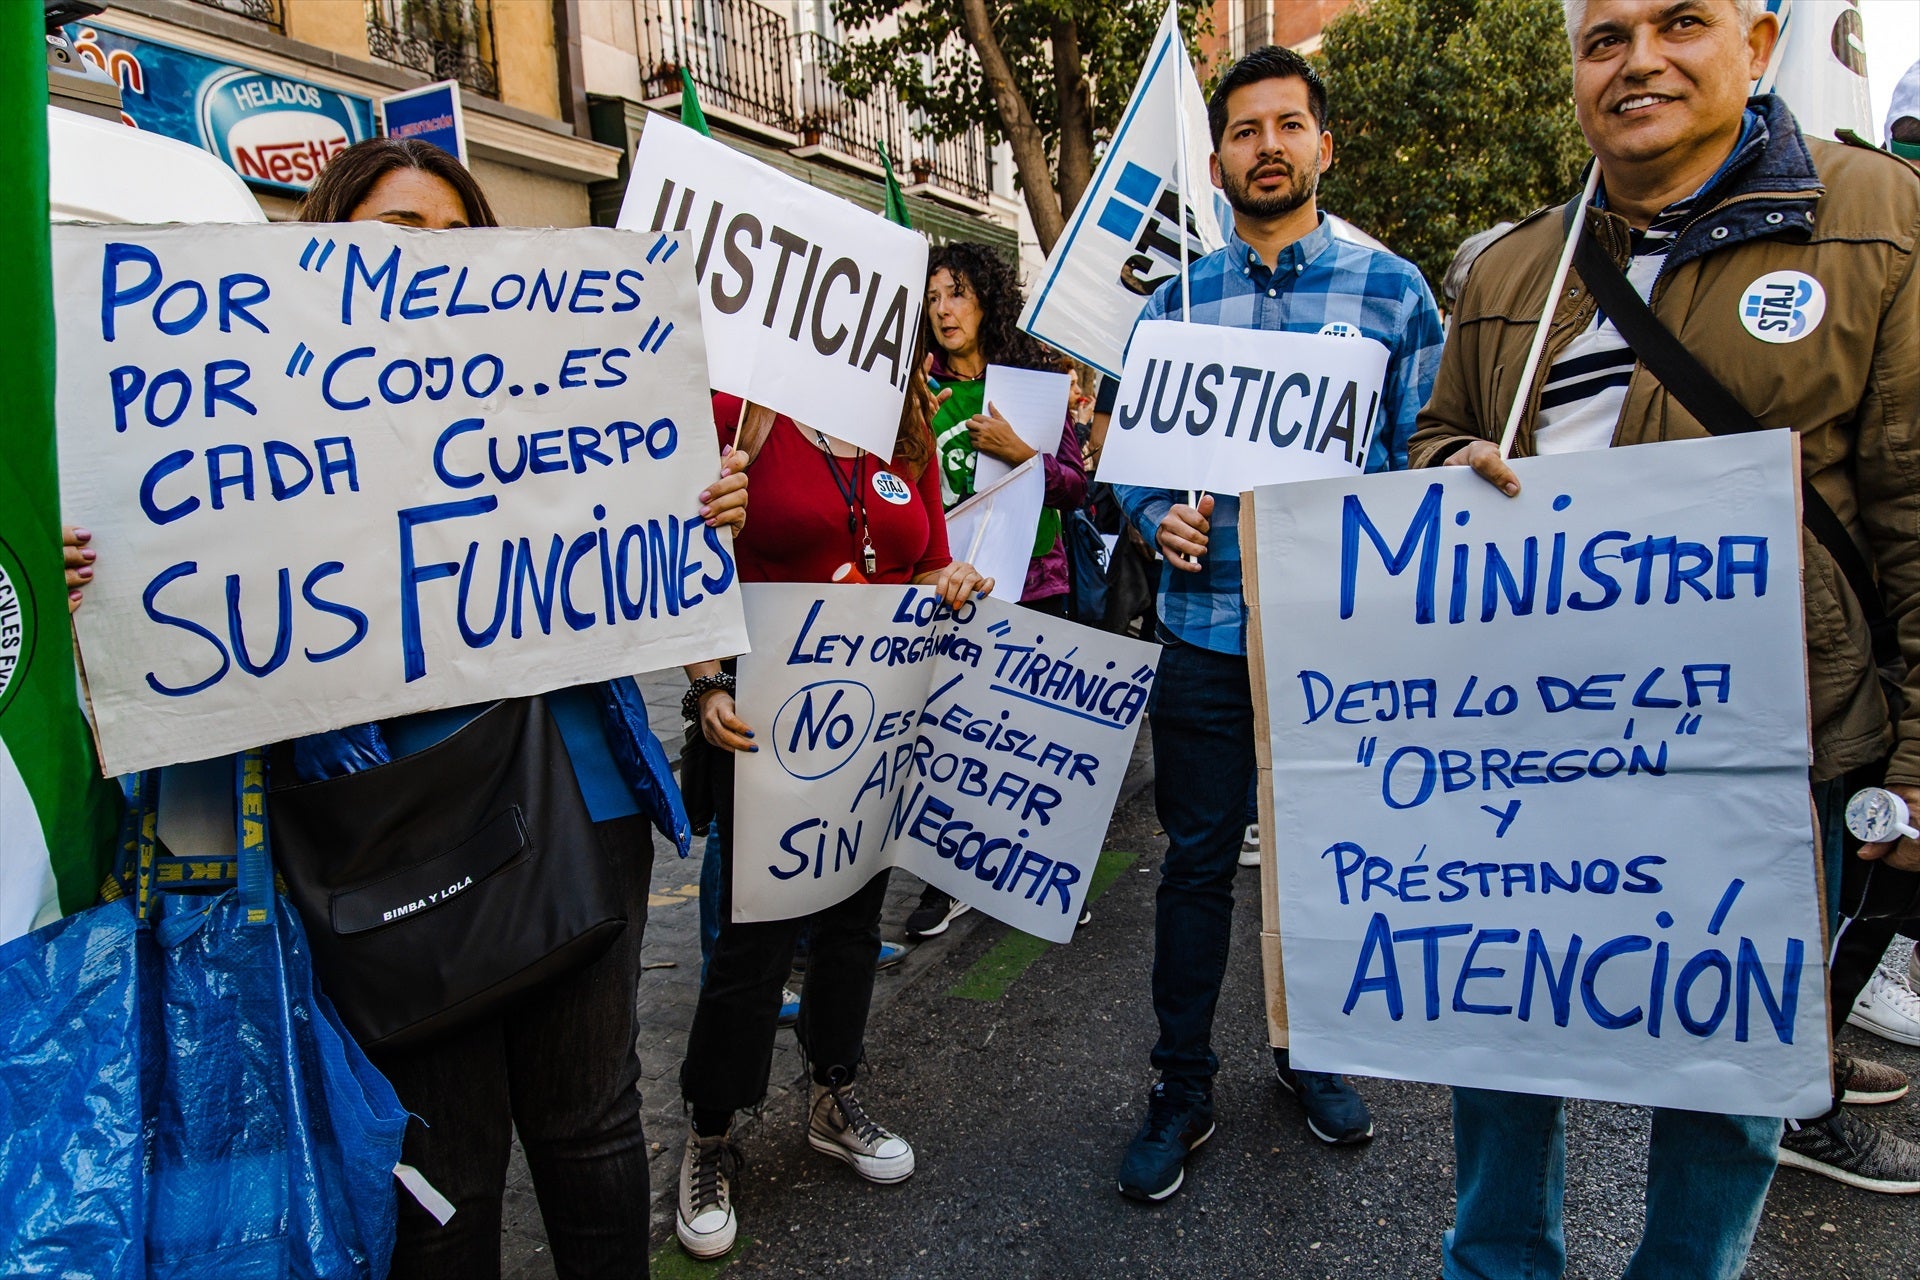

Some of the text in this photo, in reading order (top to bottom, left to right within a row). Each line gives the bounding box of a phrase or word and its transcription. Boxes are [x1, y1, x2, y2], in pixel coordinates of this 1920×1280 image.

[231, 80, 322, 111] HELADOS
[101, 234, 679, 342] POR "MELONES"
[1758, 284, 1796, 331] STAJ
[109, 359, 257, 432] POR
[1119, 358, 1378, 469] JUSTICIA!
[139, 417, 678, 525] CADA CUERPO
[877, 478, 904, 494] STAJ
[142, 494, 735, 697] SUS FUNCIONES
[1340, 483, 1769, 625] MINISTRA
[787, 600, 1156, 727] LEY ORGÁNICA "TIRÁNICA"
[1297, 669, 1438, 725] DEJA
[1453, 675, 1519, 718] LO
[788, 673, 1101, 787] NO ES LEGISLAR
[1356, 713, 1702, 810] "OBREGÓN"
[850, 735, 1064, 827] APROBAR
[1480, 800, 1523, 838] Y
[157, 862, 238, 882] IKE
[768, 782, 1082, 915] SIN NEGOCIAR
[1320, 842, 1668, 905] PRÉSTANOS
[383, 876, 473, 922] BIMBA Y LOLA
[1342, 878, 1805, 1046] ATENCIÓN
